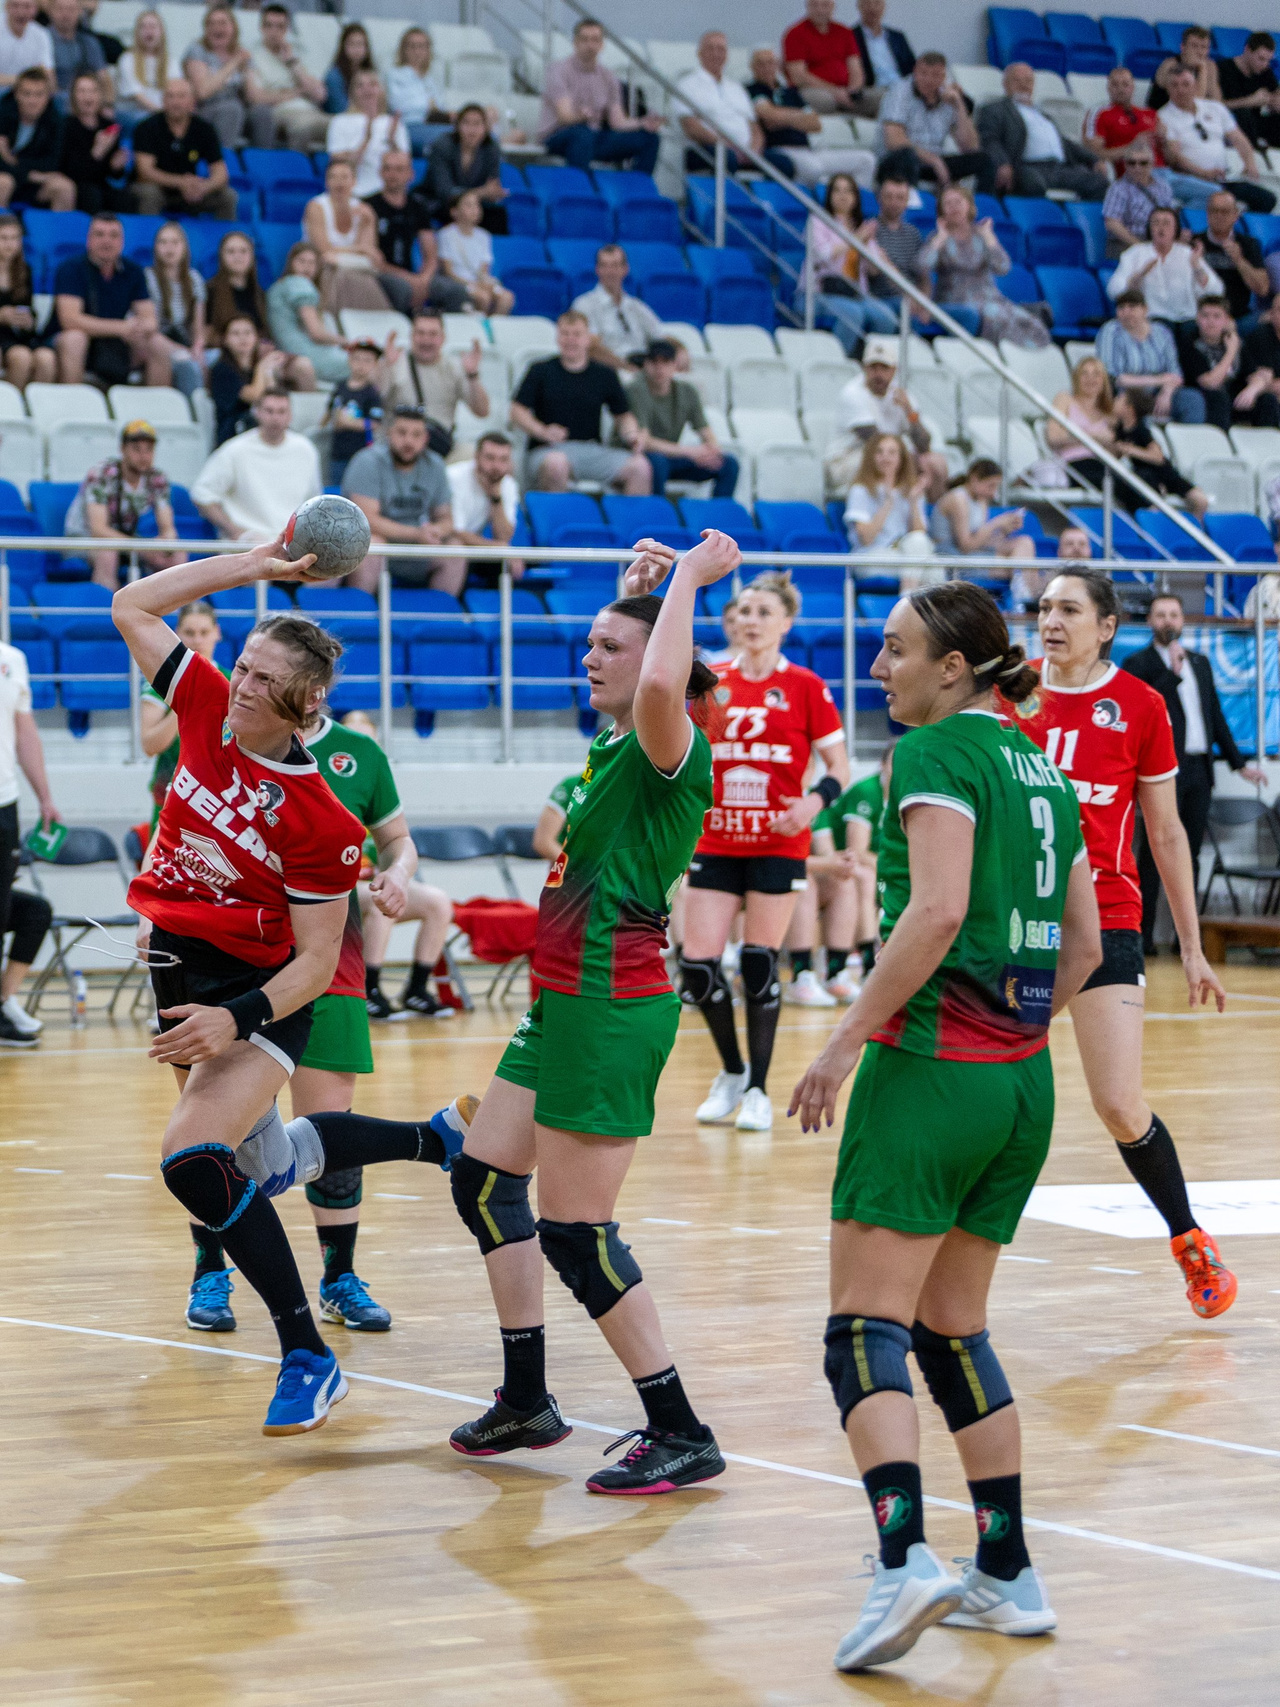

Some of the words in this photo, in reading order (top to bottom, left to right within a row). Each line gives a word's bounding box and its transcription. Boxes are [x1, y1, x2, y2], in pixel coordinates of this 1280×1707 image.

[725, 706, 769, 740] 73
[1046, 727, 1078, 771] 11
[1029, 796, 1057, 898] 3
